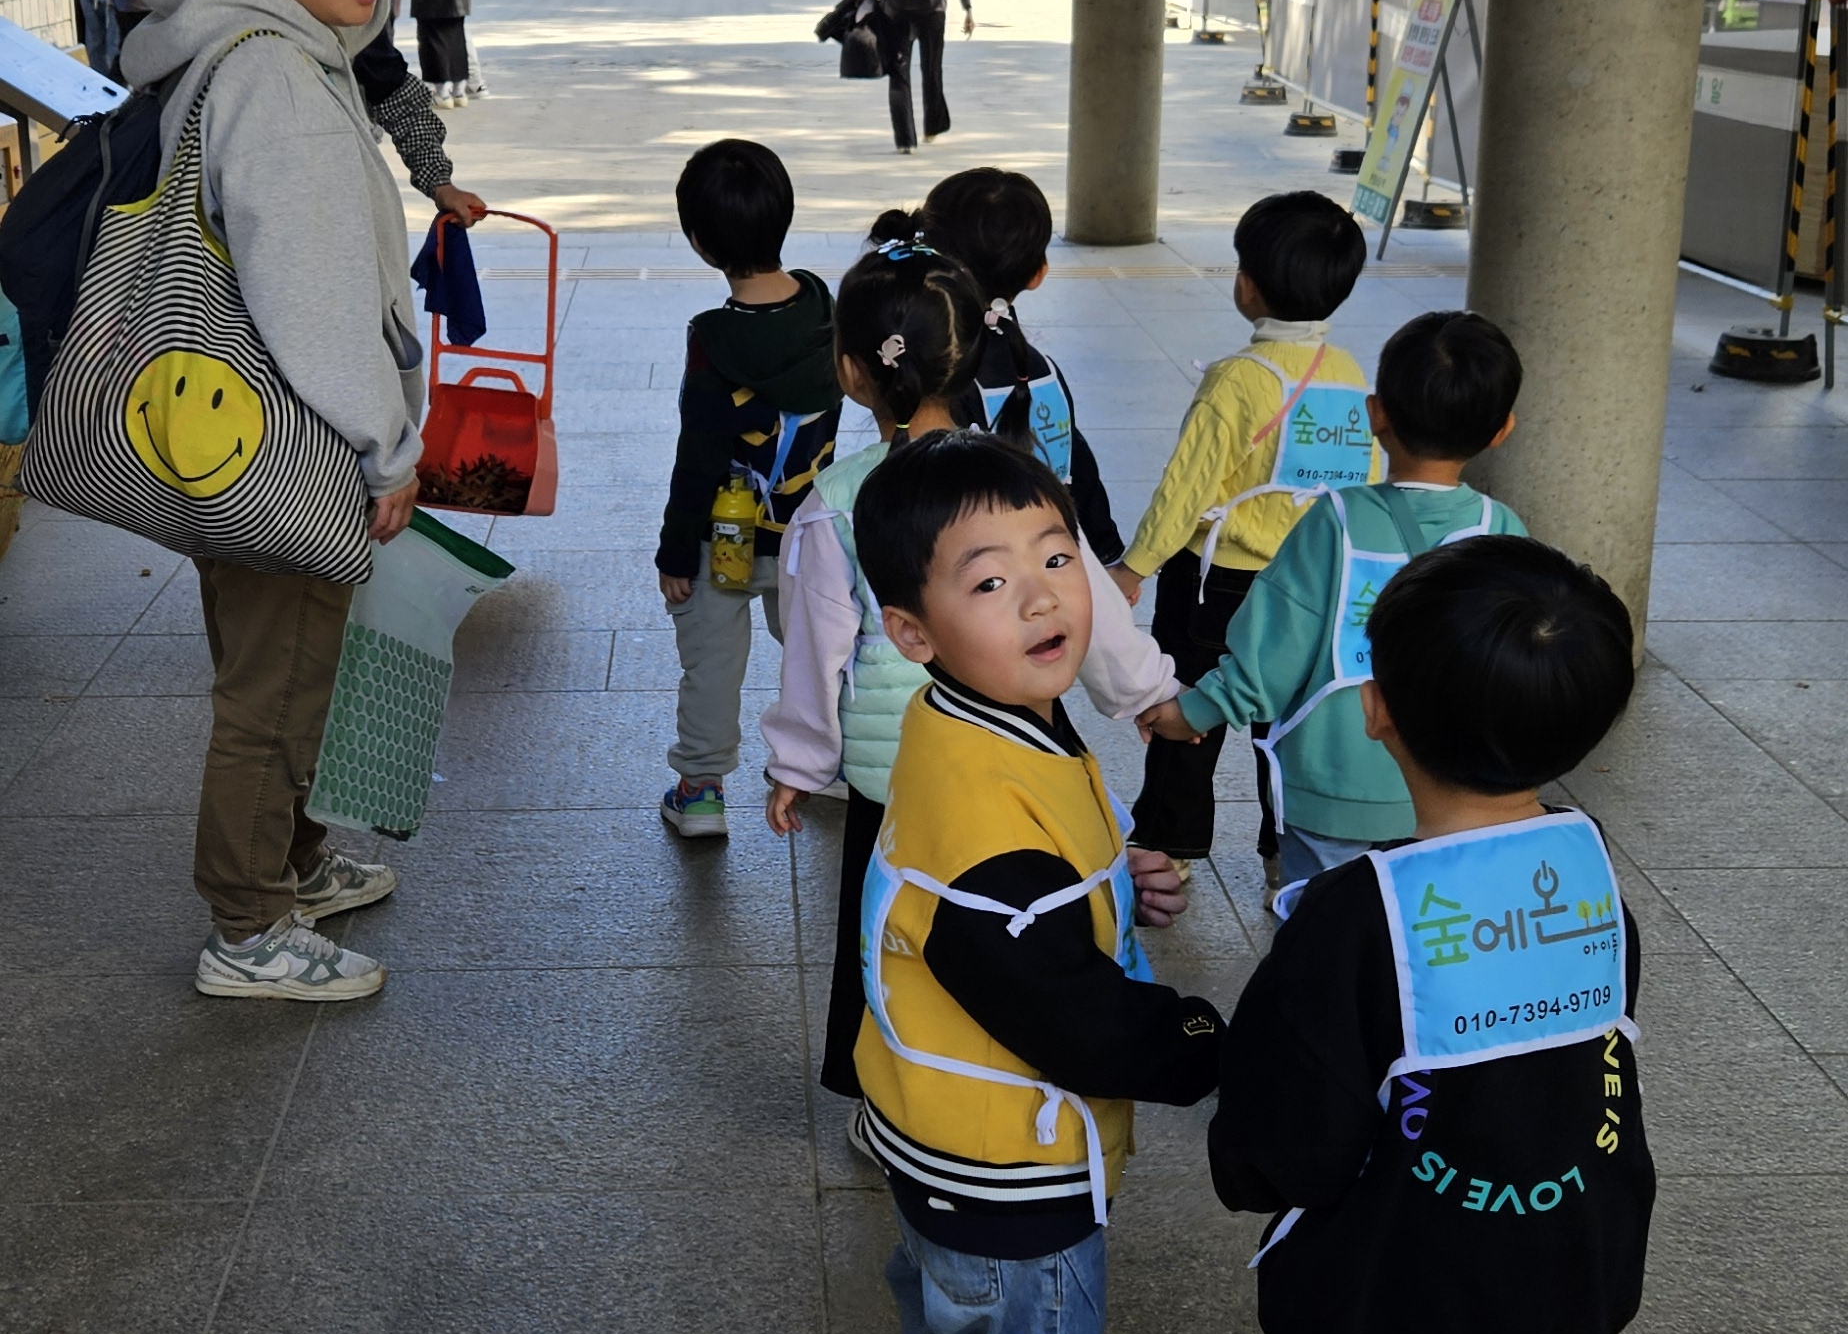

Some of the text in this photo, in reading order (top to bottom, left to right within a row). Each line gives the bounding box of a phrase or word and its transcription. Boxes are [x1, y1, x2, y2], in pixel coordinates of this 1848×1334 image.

[1292, 403, 1372, 447] 숲에온
[1412, 860, 1618, 967] 숲에온
[1454, 985, 1611, 1035] 010-7394-9709
[1596, 1108, 1621, 1155] IS
[1411, 1151, 1585, 1215] LOVE IS
